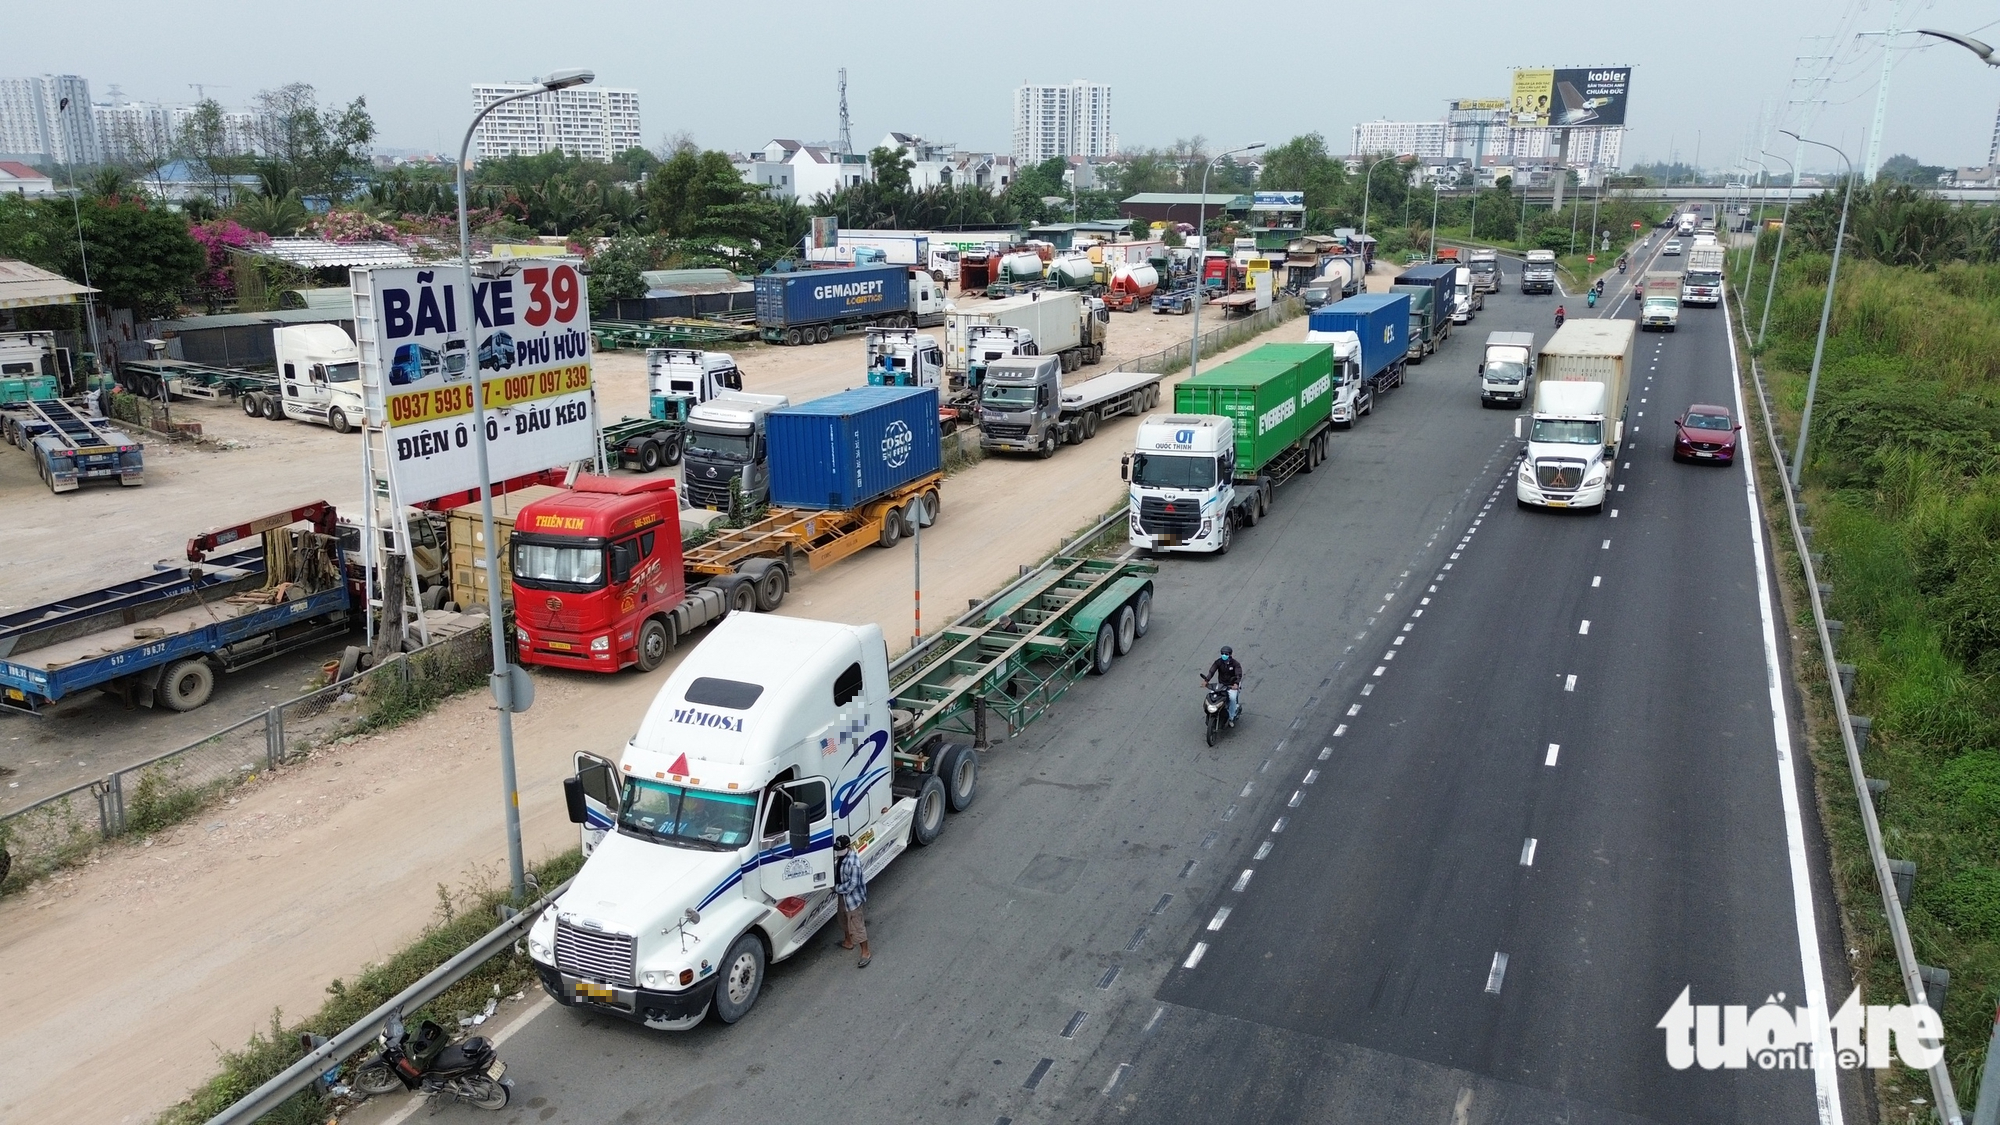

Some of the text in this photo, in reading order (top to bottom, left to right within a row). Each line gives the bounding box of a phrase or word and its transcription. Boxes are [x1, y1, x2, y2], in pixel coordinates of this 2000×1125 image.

[1588, 70, 1626, 81] kobler
[814, 280, 884, 300] GEMADEPT
[846, 294, 883, 305] LOGISTICS
[382, 264, 579, 340] BÃI XE 39
[516, 328, 586, 367] PHÚ HỮU
[392, 392, 429, 422] 0937
[435, 387, 461, 414] 593
[465, 382, 491, 412] 67
[504, 375, 535, 401] 0907
[539, 370, 561, 395] 097
[565, 365, 588, 389] 339
[1258, 396, 1296, 436] EVERGREEN
[397, 429, 450, 461] ĐIỆN
[455, 423, 468, 448] Ô
[515, 403, 551, 435] ĐẦU
[556, 399, 587, 426] KÉO
[881, 430, 913, 452] COSCO
[1175, 429, 1196, 444] QT
[535, 514, 585, 530] THIÊN KIM
